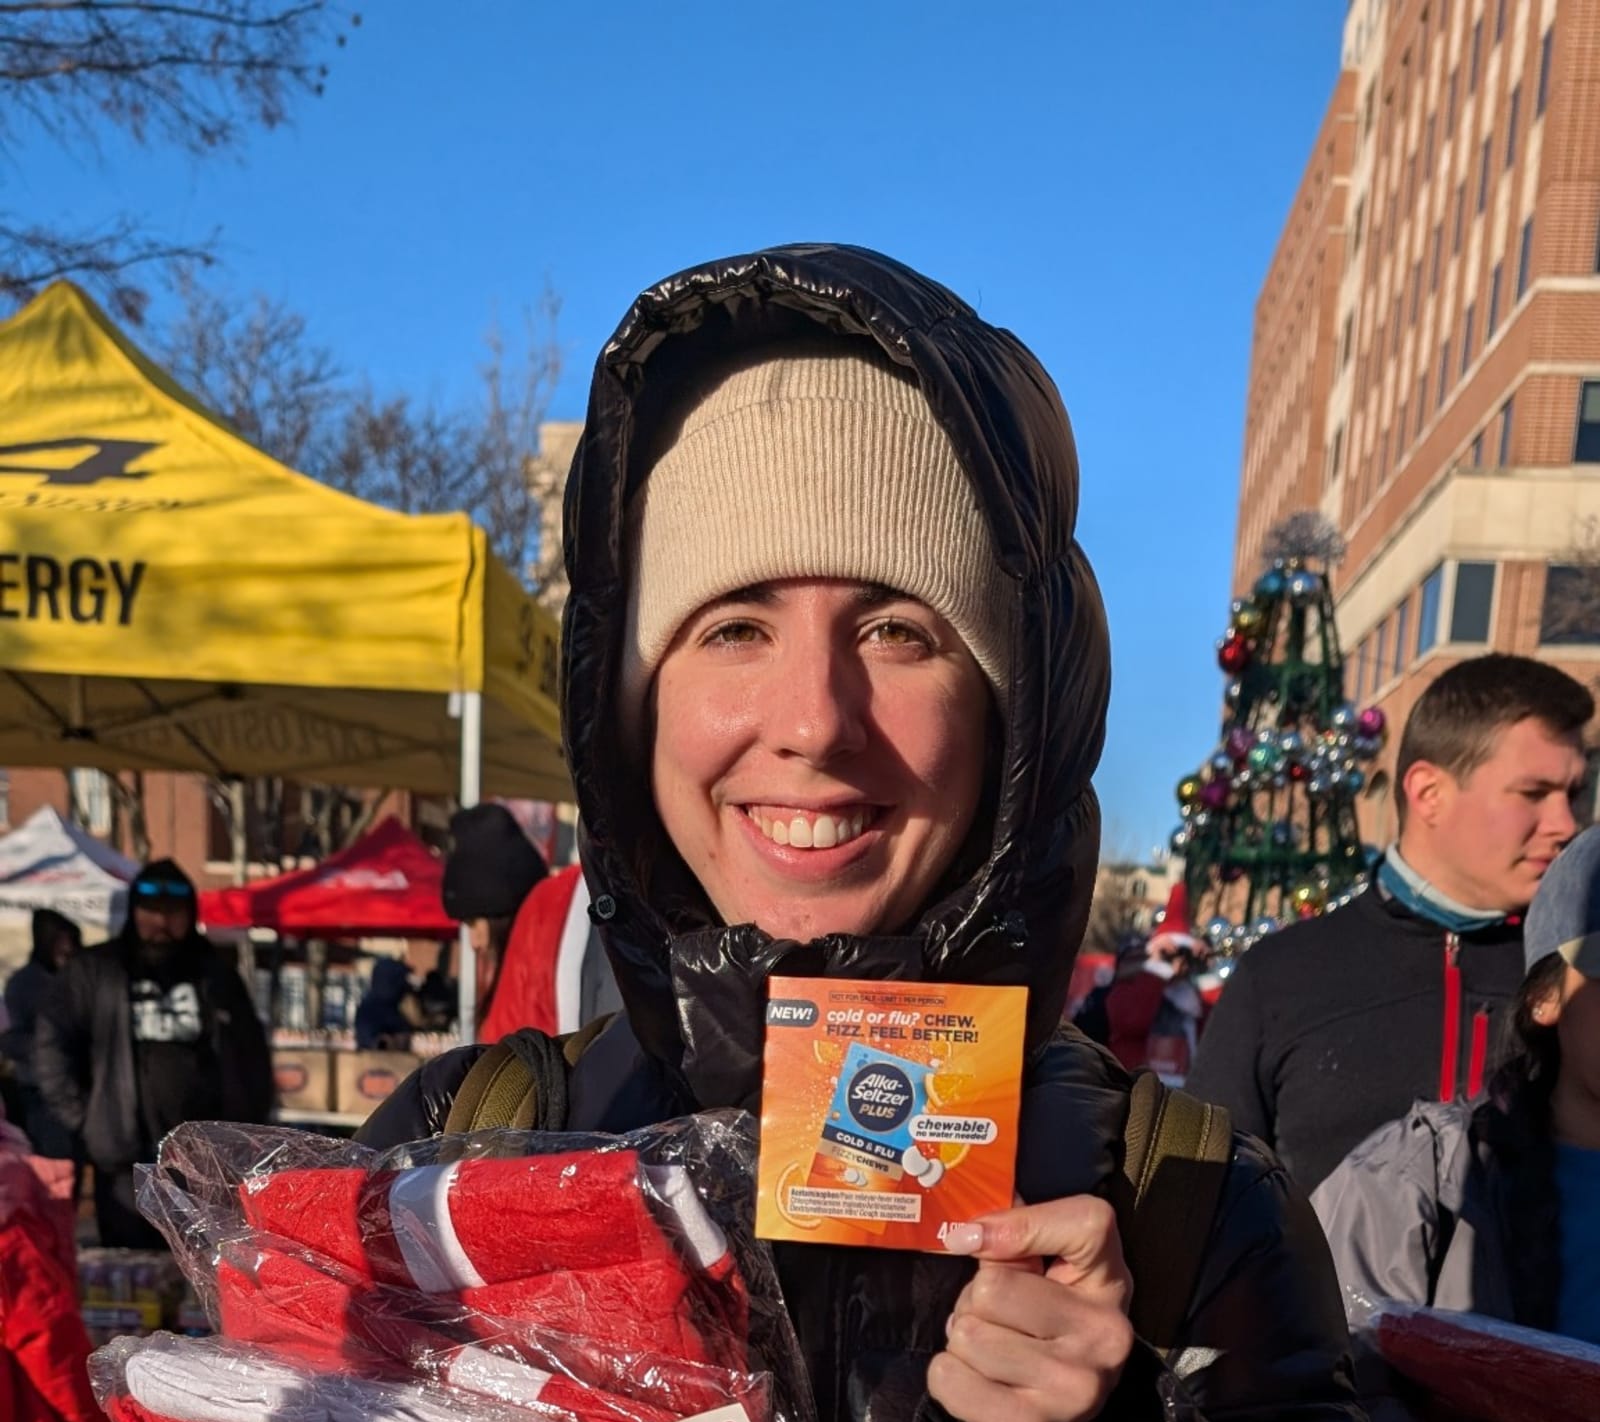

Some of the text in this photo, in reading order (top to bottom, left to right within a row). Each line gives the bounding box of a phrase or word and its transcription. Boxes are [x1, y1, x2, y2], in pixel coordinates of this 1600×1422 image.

[770, 1006, 813, 1020] NEW!
[827, 1009, 976, 1028] cold or flu? CHEW.
[826, 1024, 979, 1043] FIZZ. FEEL BETTER!
[859, 1073, 903, 1091] Alka-
[851, 1085, 909, 1106] Seltzer
[859, 1103, 897, 1119] PLUS
[917, 1119, 991, 1133] chewable!
[836, 1131, 896, 1159] COLD & FLU
